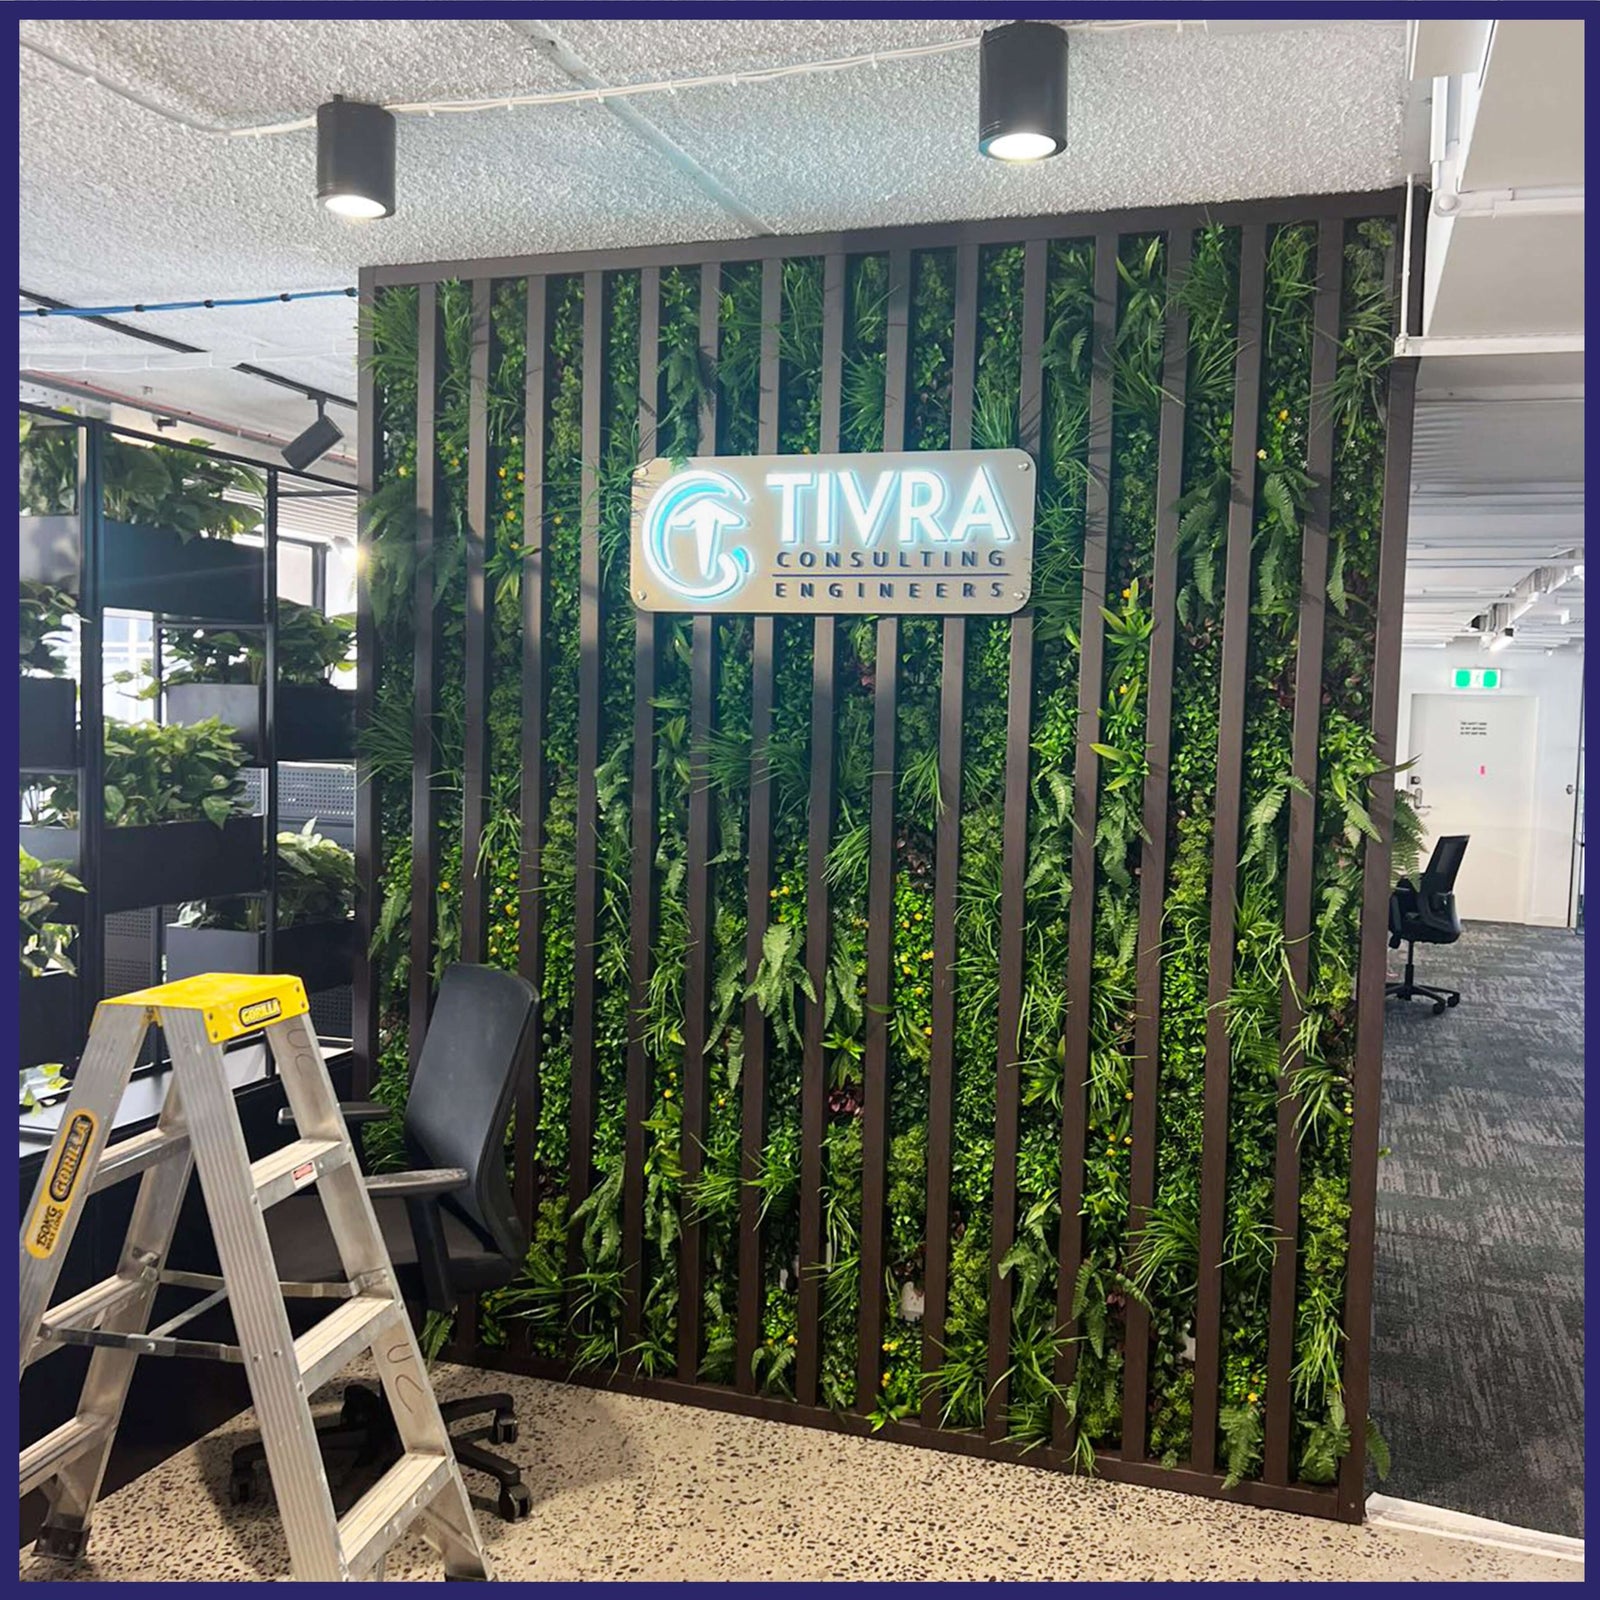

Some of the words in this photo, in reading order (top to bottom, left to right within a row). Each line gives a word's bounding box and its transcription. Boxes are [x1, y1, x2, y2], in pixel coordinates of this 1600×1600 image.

[766, 465, 1016, 545] TIVRA
[776, 550, 1004, 568] CONSULTING
[775, 582, 1003, 598] ENGINEERS
[241, 999, 280, 1024] GORILLA
[54, 1120, 89, 1196] GORILLA
[36, 1205, 58, 1246] 150KG
